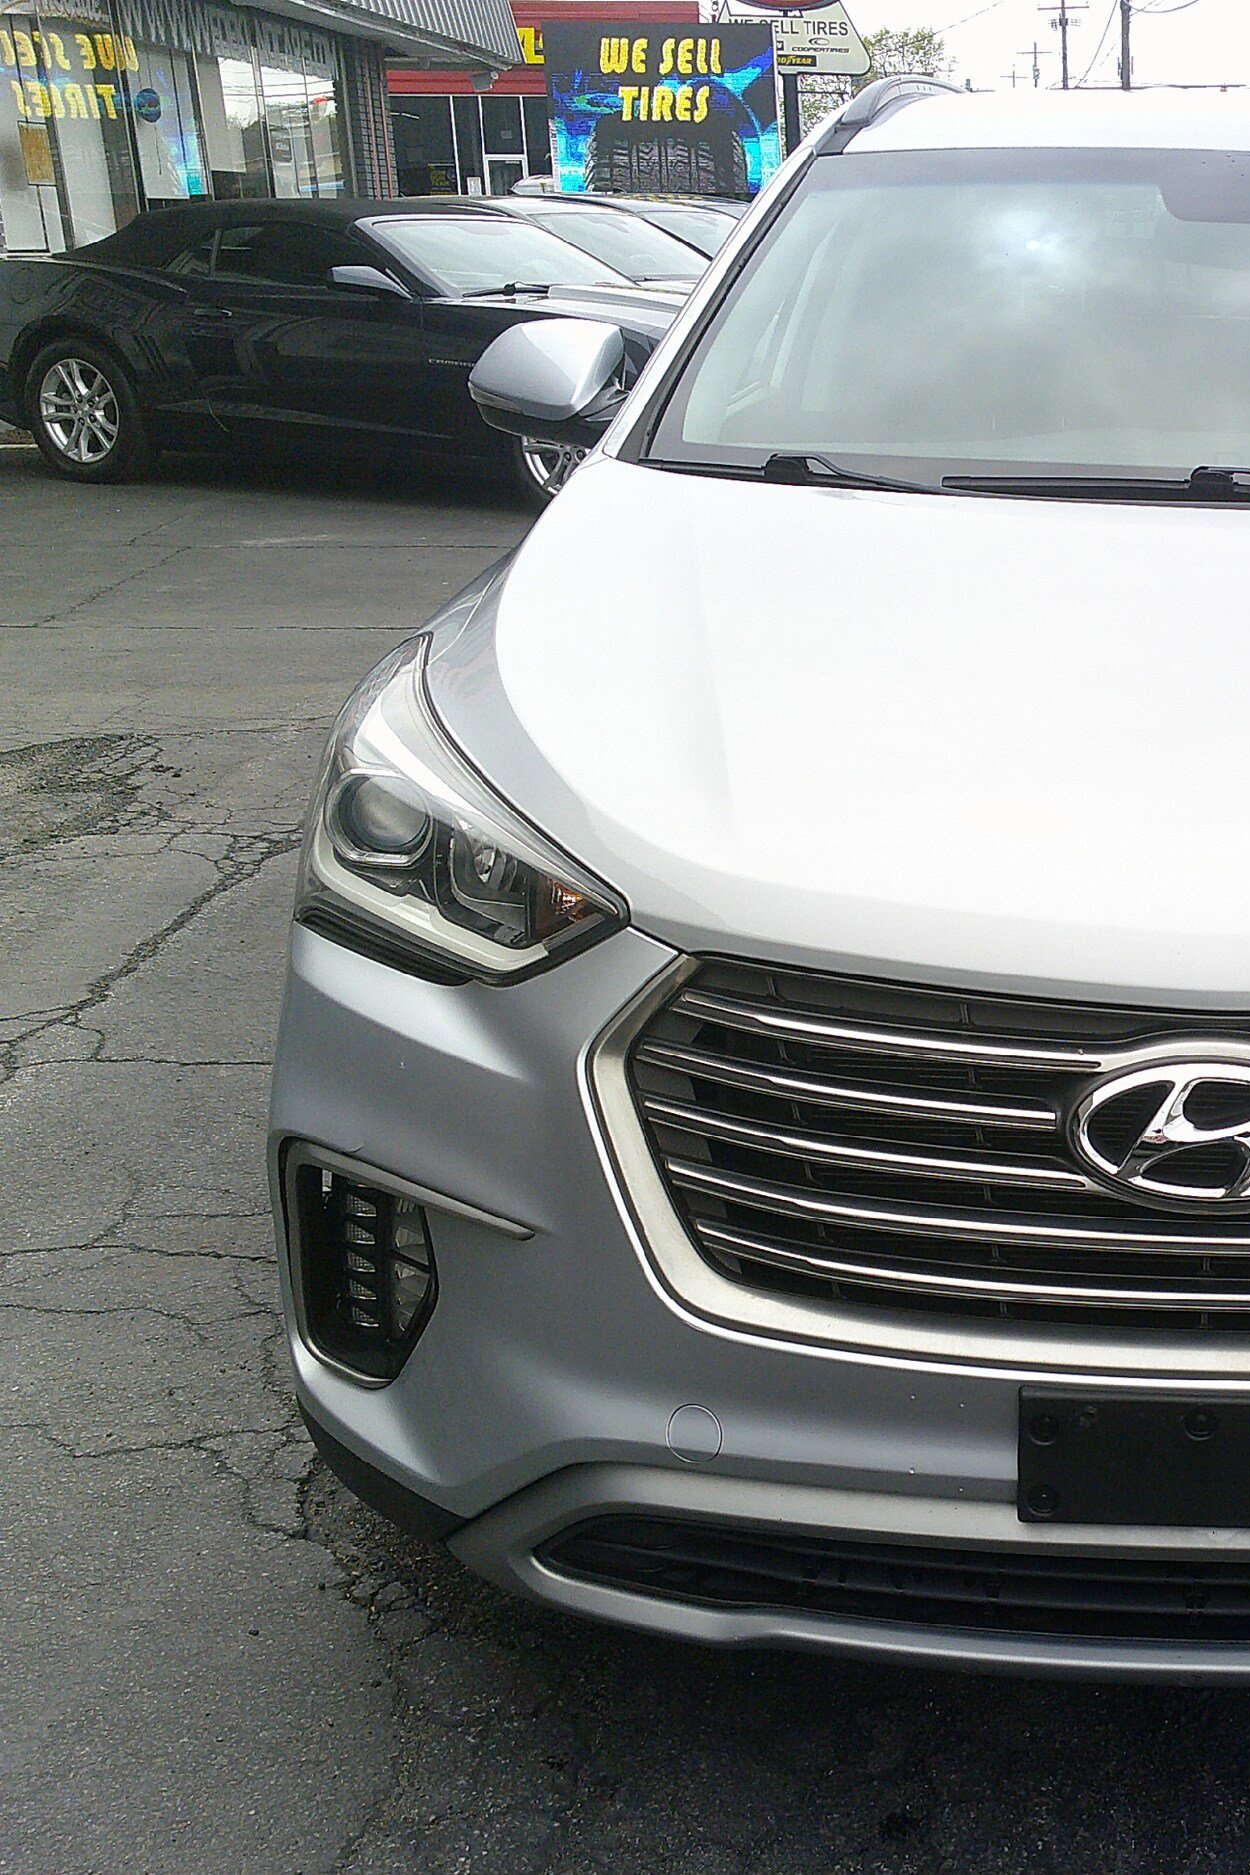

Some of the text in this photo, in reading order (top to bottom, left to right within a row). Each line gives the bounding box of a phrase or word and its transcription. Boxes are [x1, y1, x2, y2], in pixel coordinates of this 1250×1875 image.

[803, 21, 849, 36] TIRES
[599, 37, 722, 75] WE SELL
[618, 86, 710, 123] TIRES
